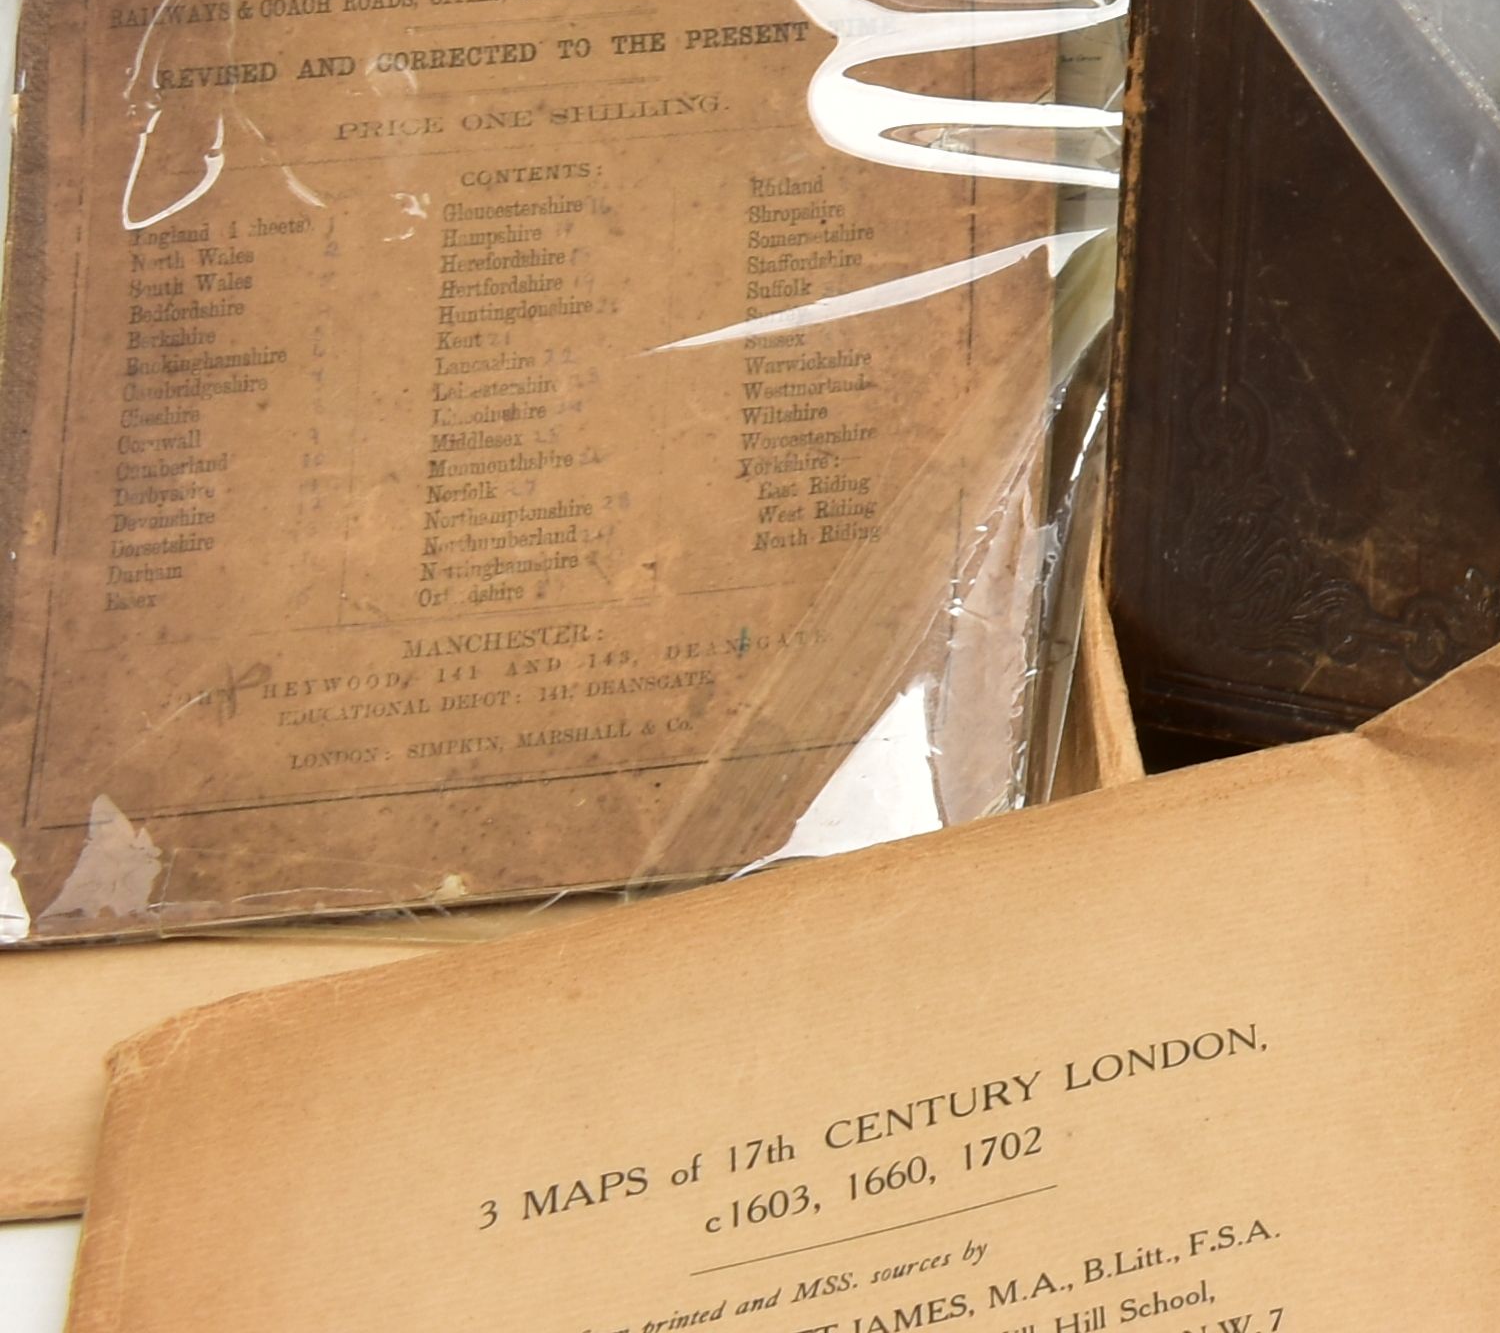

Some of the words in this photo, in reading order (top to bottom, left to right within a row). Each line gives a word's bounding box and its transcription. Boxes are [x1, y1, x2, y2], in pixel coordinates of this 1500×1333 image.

[237, 0, 254, 20] &
[157, 60, 277, 91] REVISED
[297, 54, 355, 79] AND
[376, 40, 537, 75] CORRECTED
[558, 36, 591, 60] TO
[613, 30, 666, 55] THE
[685, 21, 808, 51] PRESENT
[335, 116, 443, 141] PRICE
[462, 110, 533, 132] ONE
[460, 161, 604, 188] CONTENTS:
[442, 198, 583, 223] Gloucestershire
[748, 202, 844, 225] Shropshire
[439, 249, 565, 274] Herefordshire
[747, 252, 862, 275] Staffordshire
[402, 624, 605, 659] MANCHESTER:
[516, 720, 632, 749] MARSHALL
[478, 1198, 499, 1229] 3
[520, 1168, 650, 1221] MAPS
[671, 1153, 703, 1186] of
[727, 1138, 797, 1175] 17th
[824, 1072, 1041, 1151] CENTURY
[1065, 1024, 1269, 1092] LONDON,
[705, 1184, 821, 1234] c1603,
[847, 1154, 937, 1203] 1660,
[962, 1125, 1044, 1172] 1702
[643, 1299, 725, 1333] printed
[738, 1288, 781, 1316] and
[793, 1261, 860, 1304] MSS.
[871, 1250, 951, 1286] sources
[961, 1238, 989, 1266] by
[852, 1293, 977, 1333] JAMES,
[989, 1271, 1075, 1310] M.A.,
[1084, 1250, 1182, 1285] B.Litt.,
[1189, 1224, 1282, 1259] F.S.A.
[1054, 1306, 1106, 1333] Hill
[1119, 1281, 1217, 1326] School,
